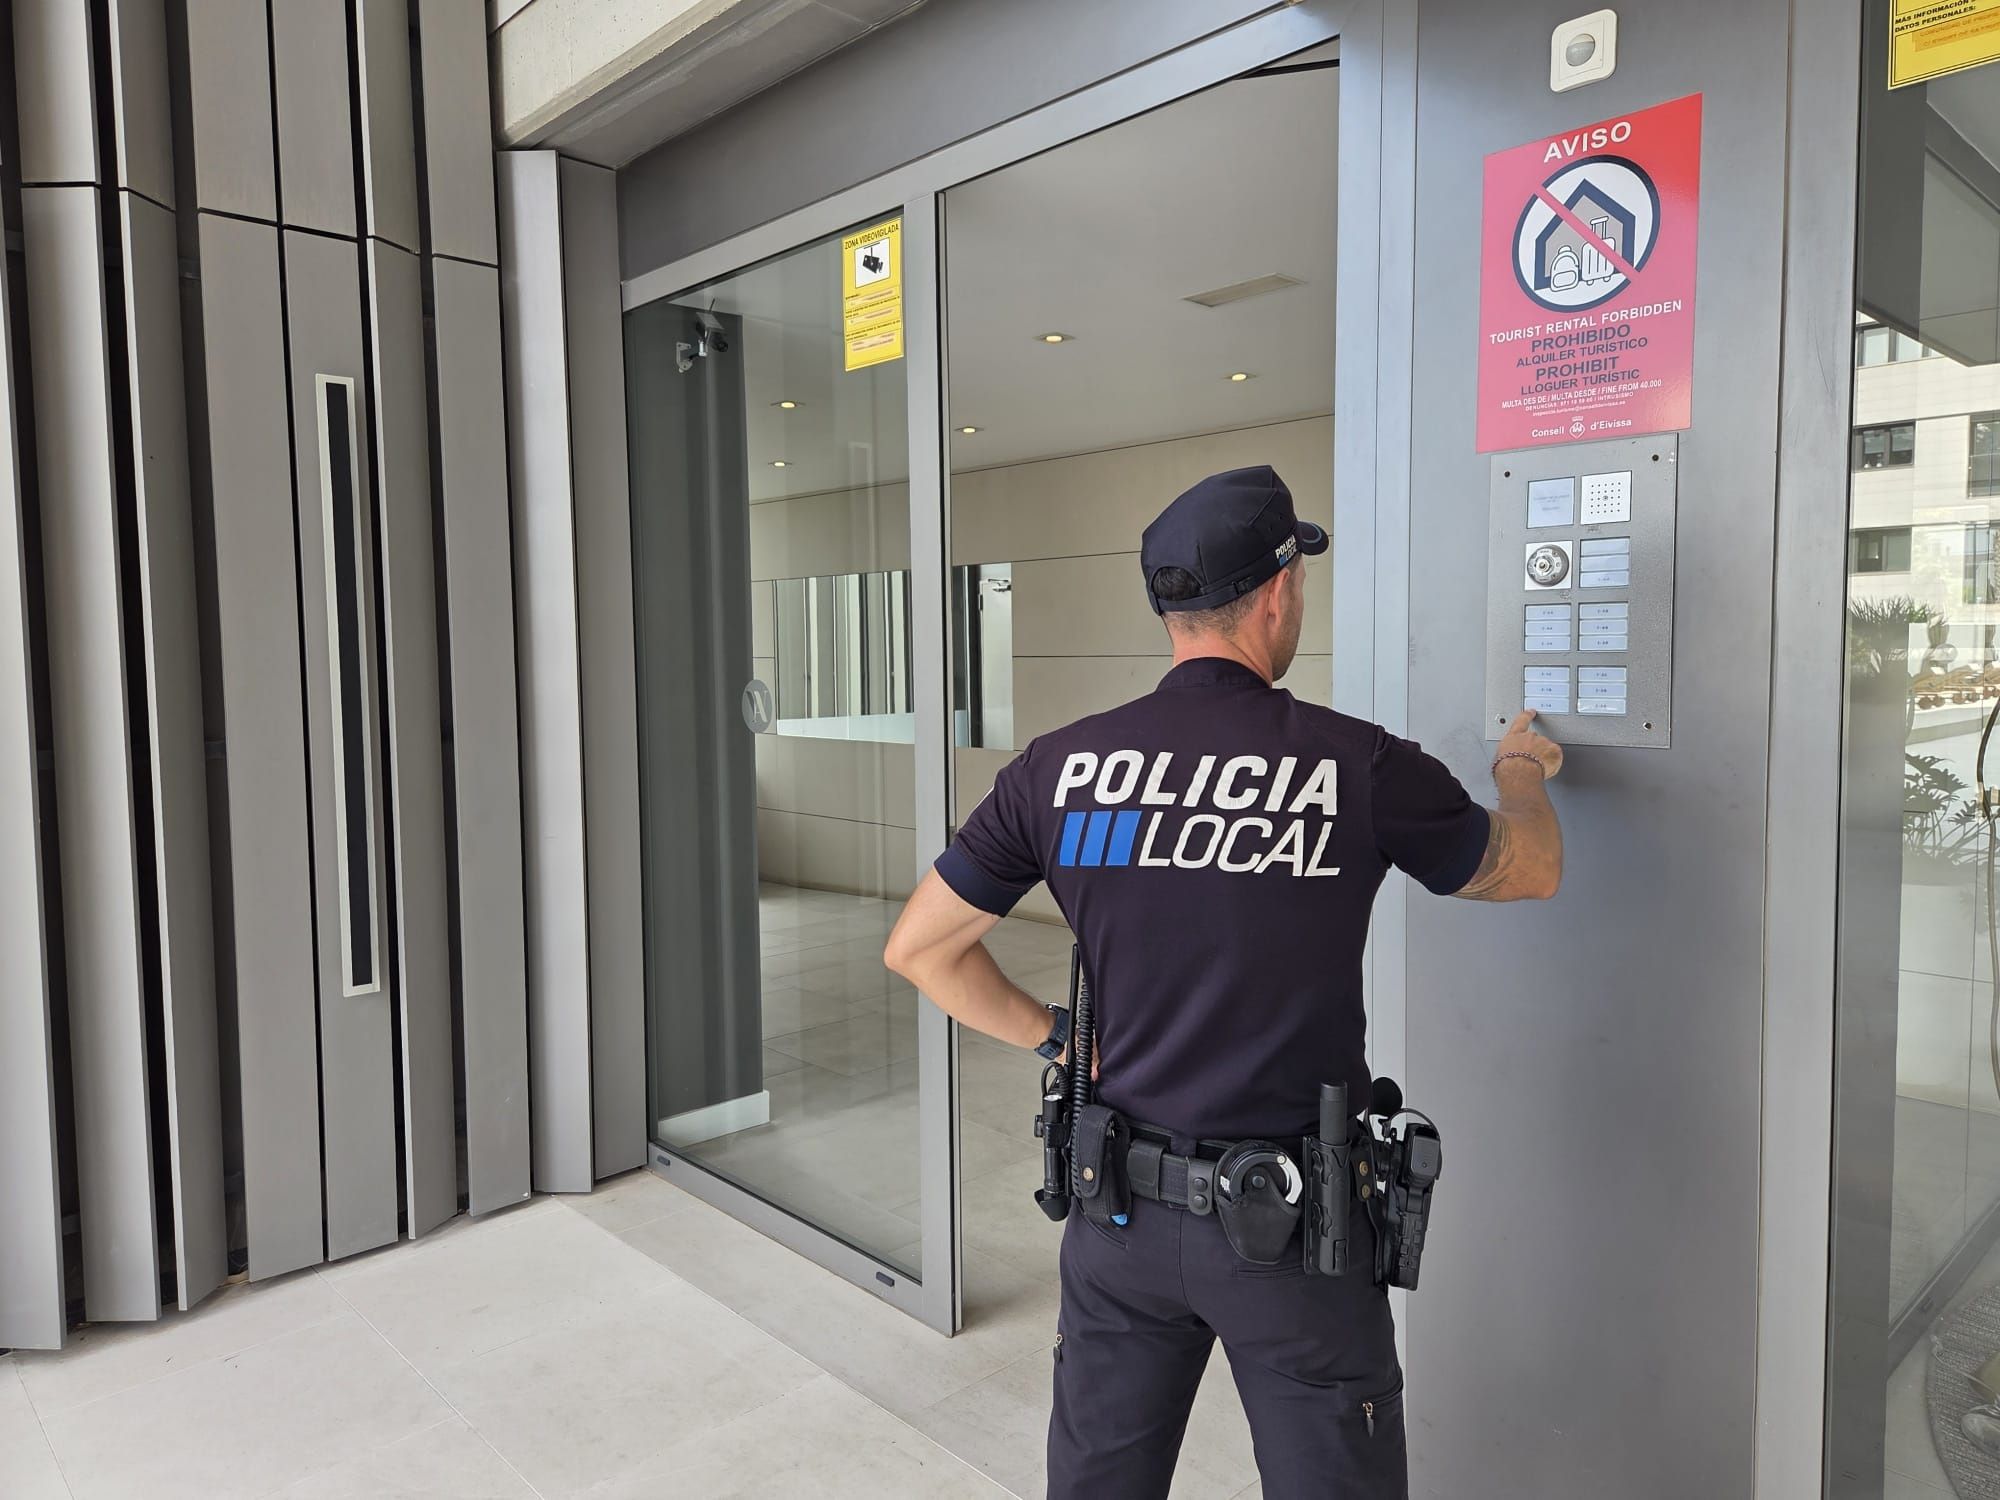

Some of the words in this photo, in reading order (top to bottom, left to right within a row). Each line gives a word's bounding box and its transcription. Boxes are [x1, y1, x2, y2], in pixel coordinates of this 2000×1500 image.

[1895, 22, 1920, 32] DATOS
[1544, 121, 1632, 164] AVISO
[844, 238, 859, 250] ZONA
[859, 224, 899, 244] VIDEOVIGILADA
[1490, 325, 1542, 344] TOURIST
[1546, 316, 1596, 334] RENTAL
[1602, 300, 1682, 324] FORBIDDEN
[1516, 348, 1576, 368] ALQUILER
[1579, 336, 1648, 358] TURÍSTICO
[1531, 324, 1631, 352] PROHIBIDO
[1520, 379, 1578, 396] LLOGUER
[1583, 368, 1640, 387] TURÍSTIC
[1536, 356, 1620, 381] PROHIBIT
[1502, 400, 1522, 408] MULTA
[1523, 397, 1536, 406] DES
[1537, 396, 1546, 404] DE
[1551, 393, 1573, 402] MULTA
[1574, 388, 1596, 398] DESDE
[1602, 385, 1617, 394] FINE
[1618, 382, 1639, 392] FROM
[1532, 426, 1564, 438] Consell
[1590, 420, 1632, 430] d'Eivissa
[1053, 750, 1337, 816] POLICIA
[1138, 812, 1340, 878] LOCAL
